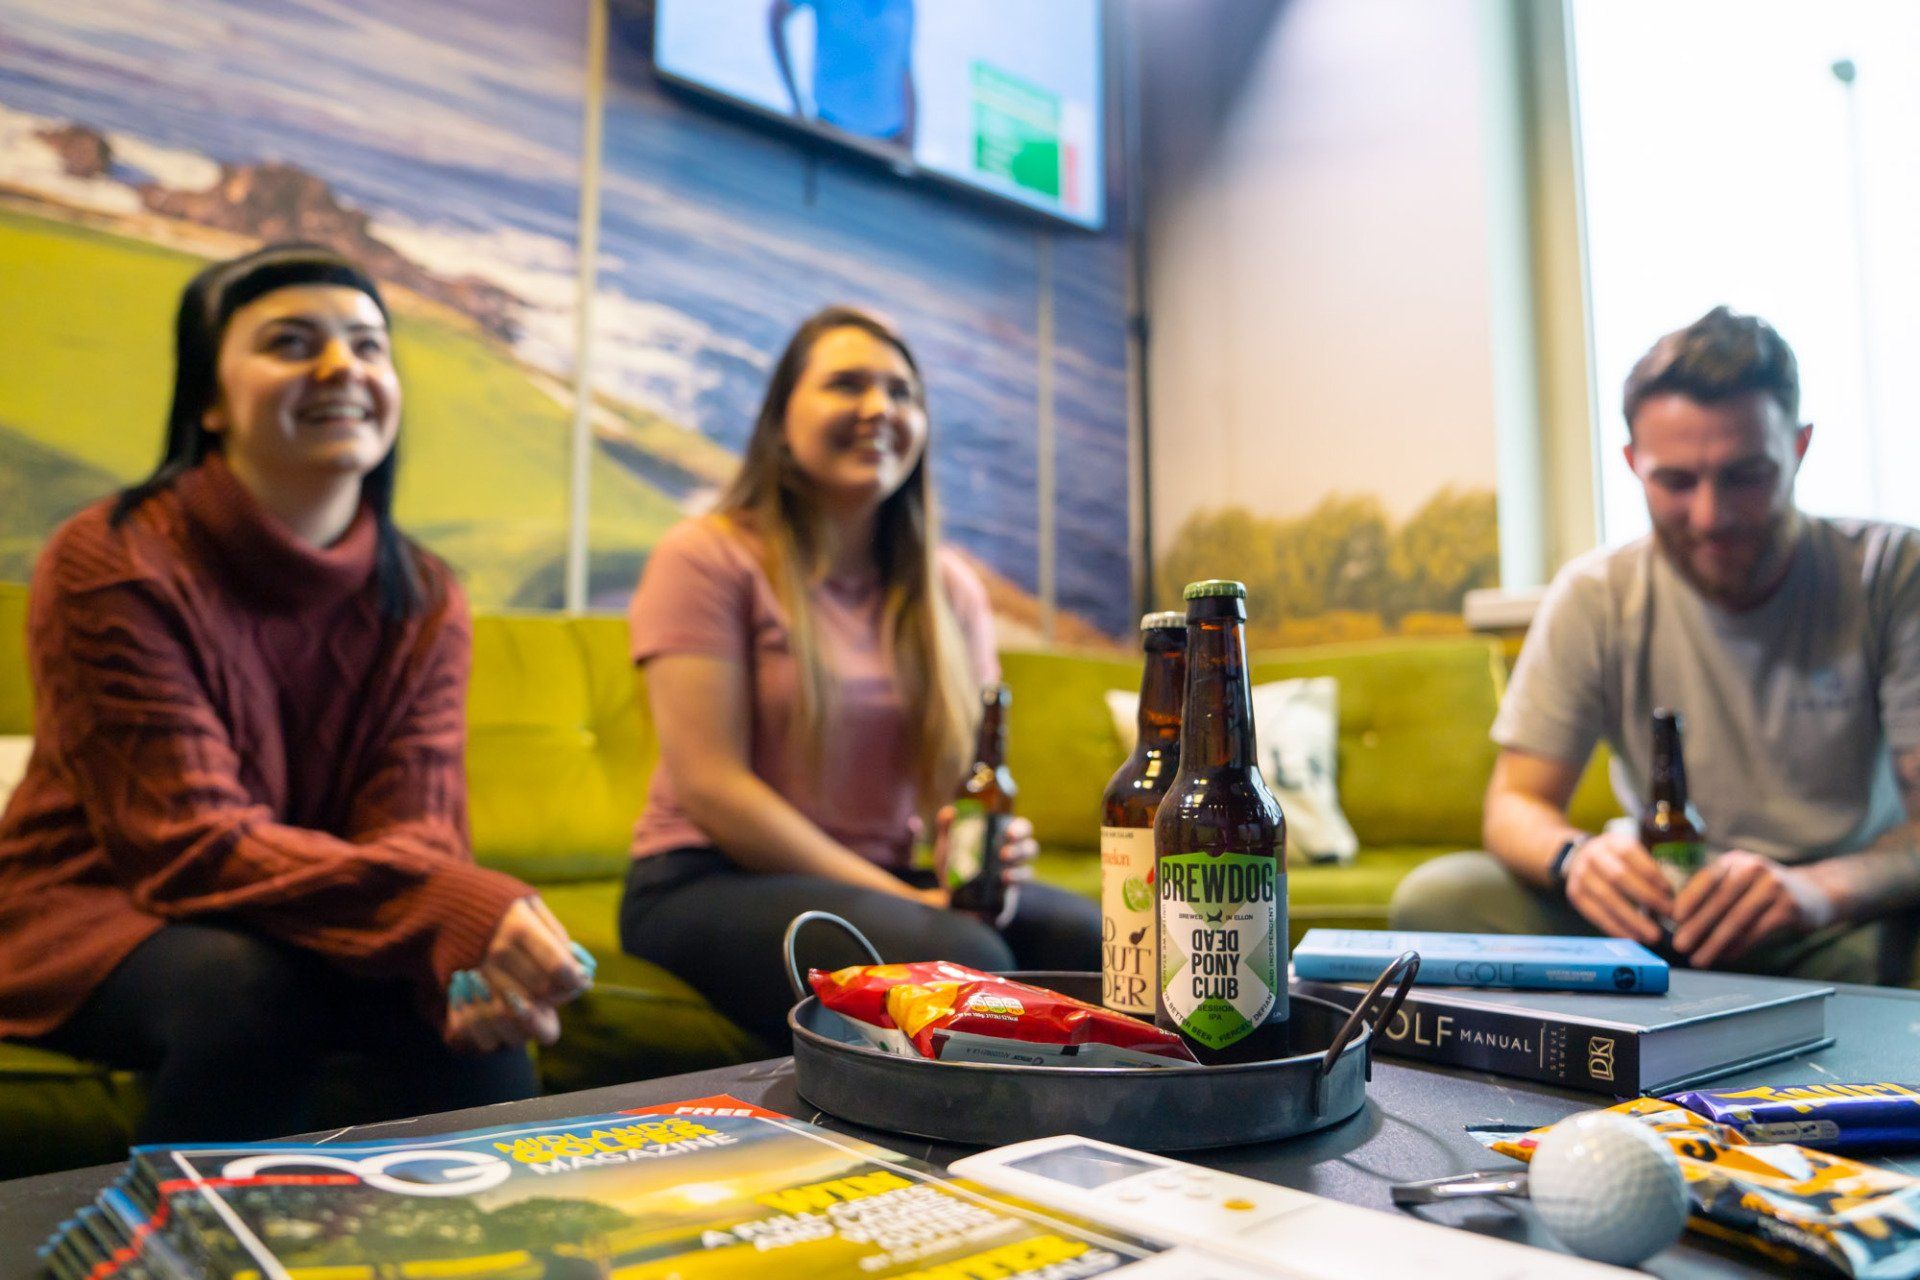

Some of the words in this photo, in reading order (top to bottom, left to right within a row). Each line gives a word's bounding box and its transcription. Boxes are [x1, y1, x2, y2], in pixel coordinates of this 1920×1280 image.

[1161, 862, 1274, 904] BREWDOG
[1225, 913, 1235, 921] IN
[1234, 913, 1254, 921] ELLON
[1191, 929, 1239, 952] DEAD
[1191, 953, 1240, 976] PONY
[1454, 960, 1525, 984] GOLF
[1191, 976, 1239, 1000] CLUB
[1168, 1002, 1192, 1028] BETTER
[1368, 1004, 1454, 1048] OLF
[1459, 1028, 1532, 1053] MANUAL
[1590, 1038, 1612, 1080] DK
[673, 1106, 753, 1118] FREE
[493, 1118, 691, 1154] MIDLANDS
[511, 1123, 718, 1164] GOLFER
[528, 1132, 739, 1175] MAGAZINE
